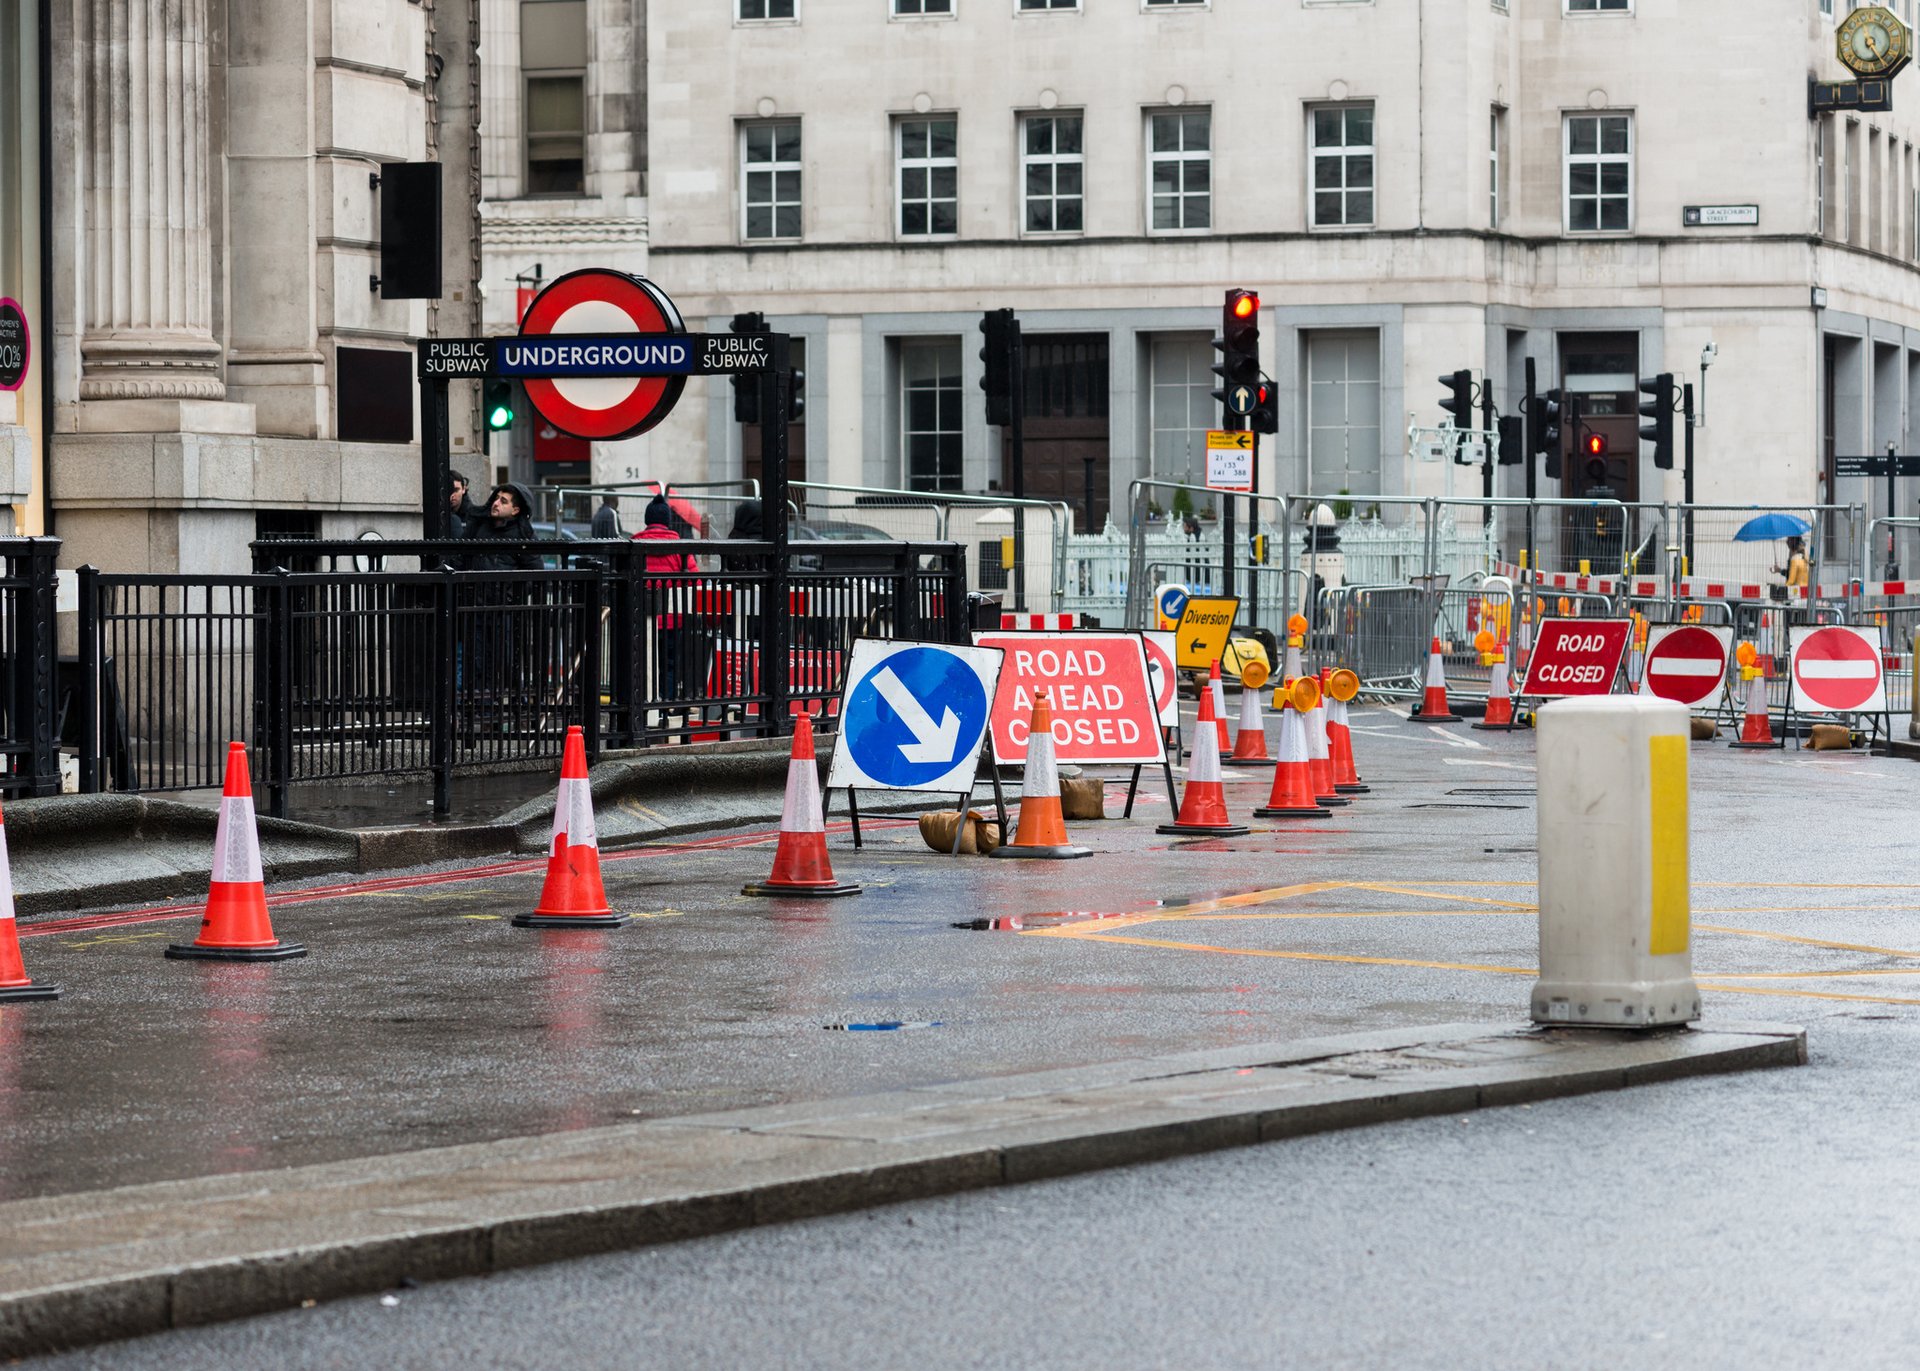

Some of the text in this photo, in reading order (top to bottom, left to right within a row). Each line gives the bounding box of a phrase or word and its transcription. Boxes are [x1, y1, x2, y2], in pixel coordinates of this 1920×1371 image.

[0, 319, 19, 328] OMEN'S
[430, 343, 485, 358] PUBLIC
[707, 337, 764, 352] PUBLIC
[505, 344, 686, 367] UNDERGROUND
[702, 352, 769, 369] SUBWAY
[425, 357, 490, 373] SUBWAY
[625, 466, 639, 479] 51
[1184, 609, 1230, 627] Diversion
[1556, 634, 1605, 652] ROAD
[1014, 649, 1107, 677] ROAD
[1538, 664, 1605, 683] CLOSED
[1008, 718, 1141, 746] COSED
